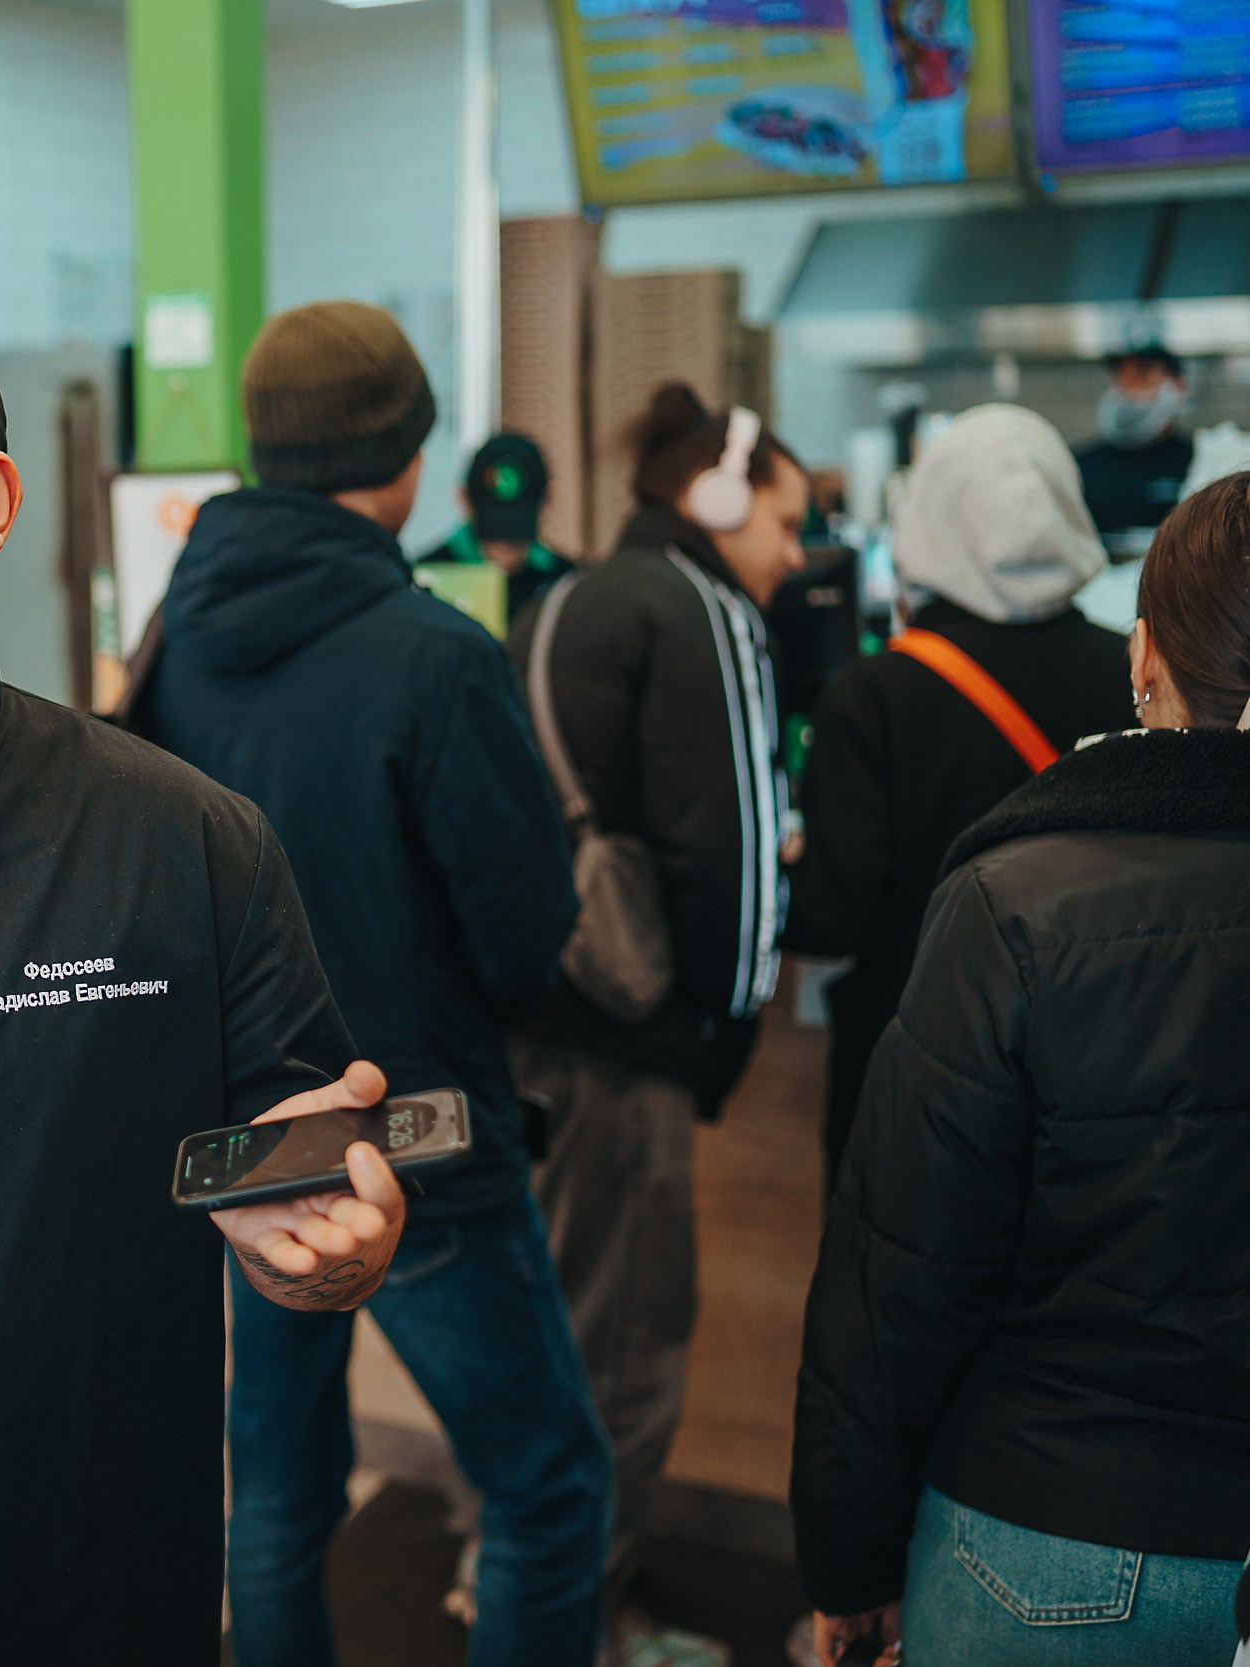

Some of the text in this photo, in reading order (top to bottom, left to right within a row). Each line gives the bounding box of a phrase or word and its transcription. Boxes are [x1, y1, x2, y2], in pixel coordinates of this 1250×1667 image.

[24, 957, 115, 980] Федосеев
[76, 980, 168, 1001] Евгеньевич
[387, 1109, 414, 1149] 16:26
